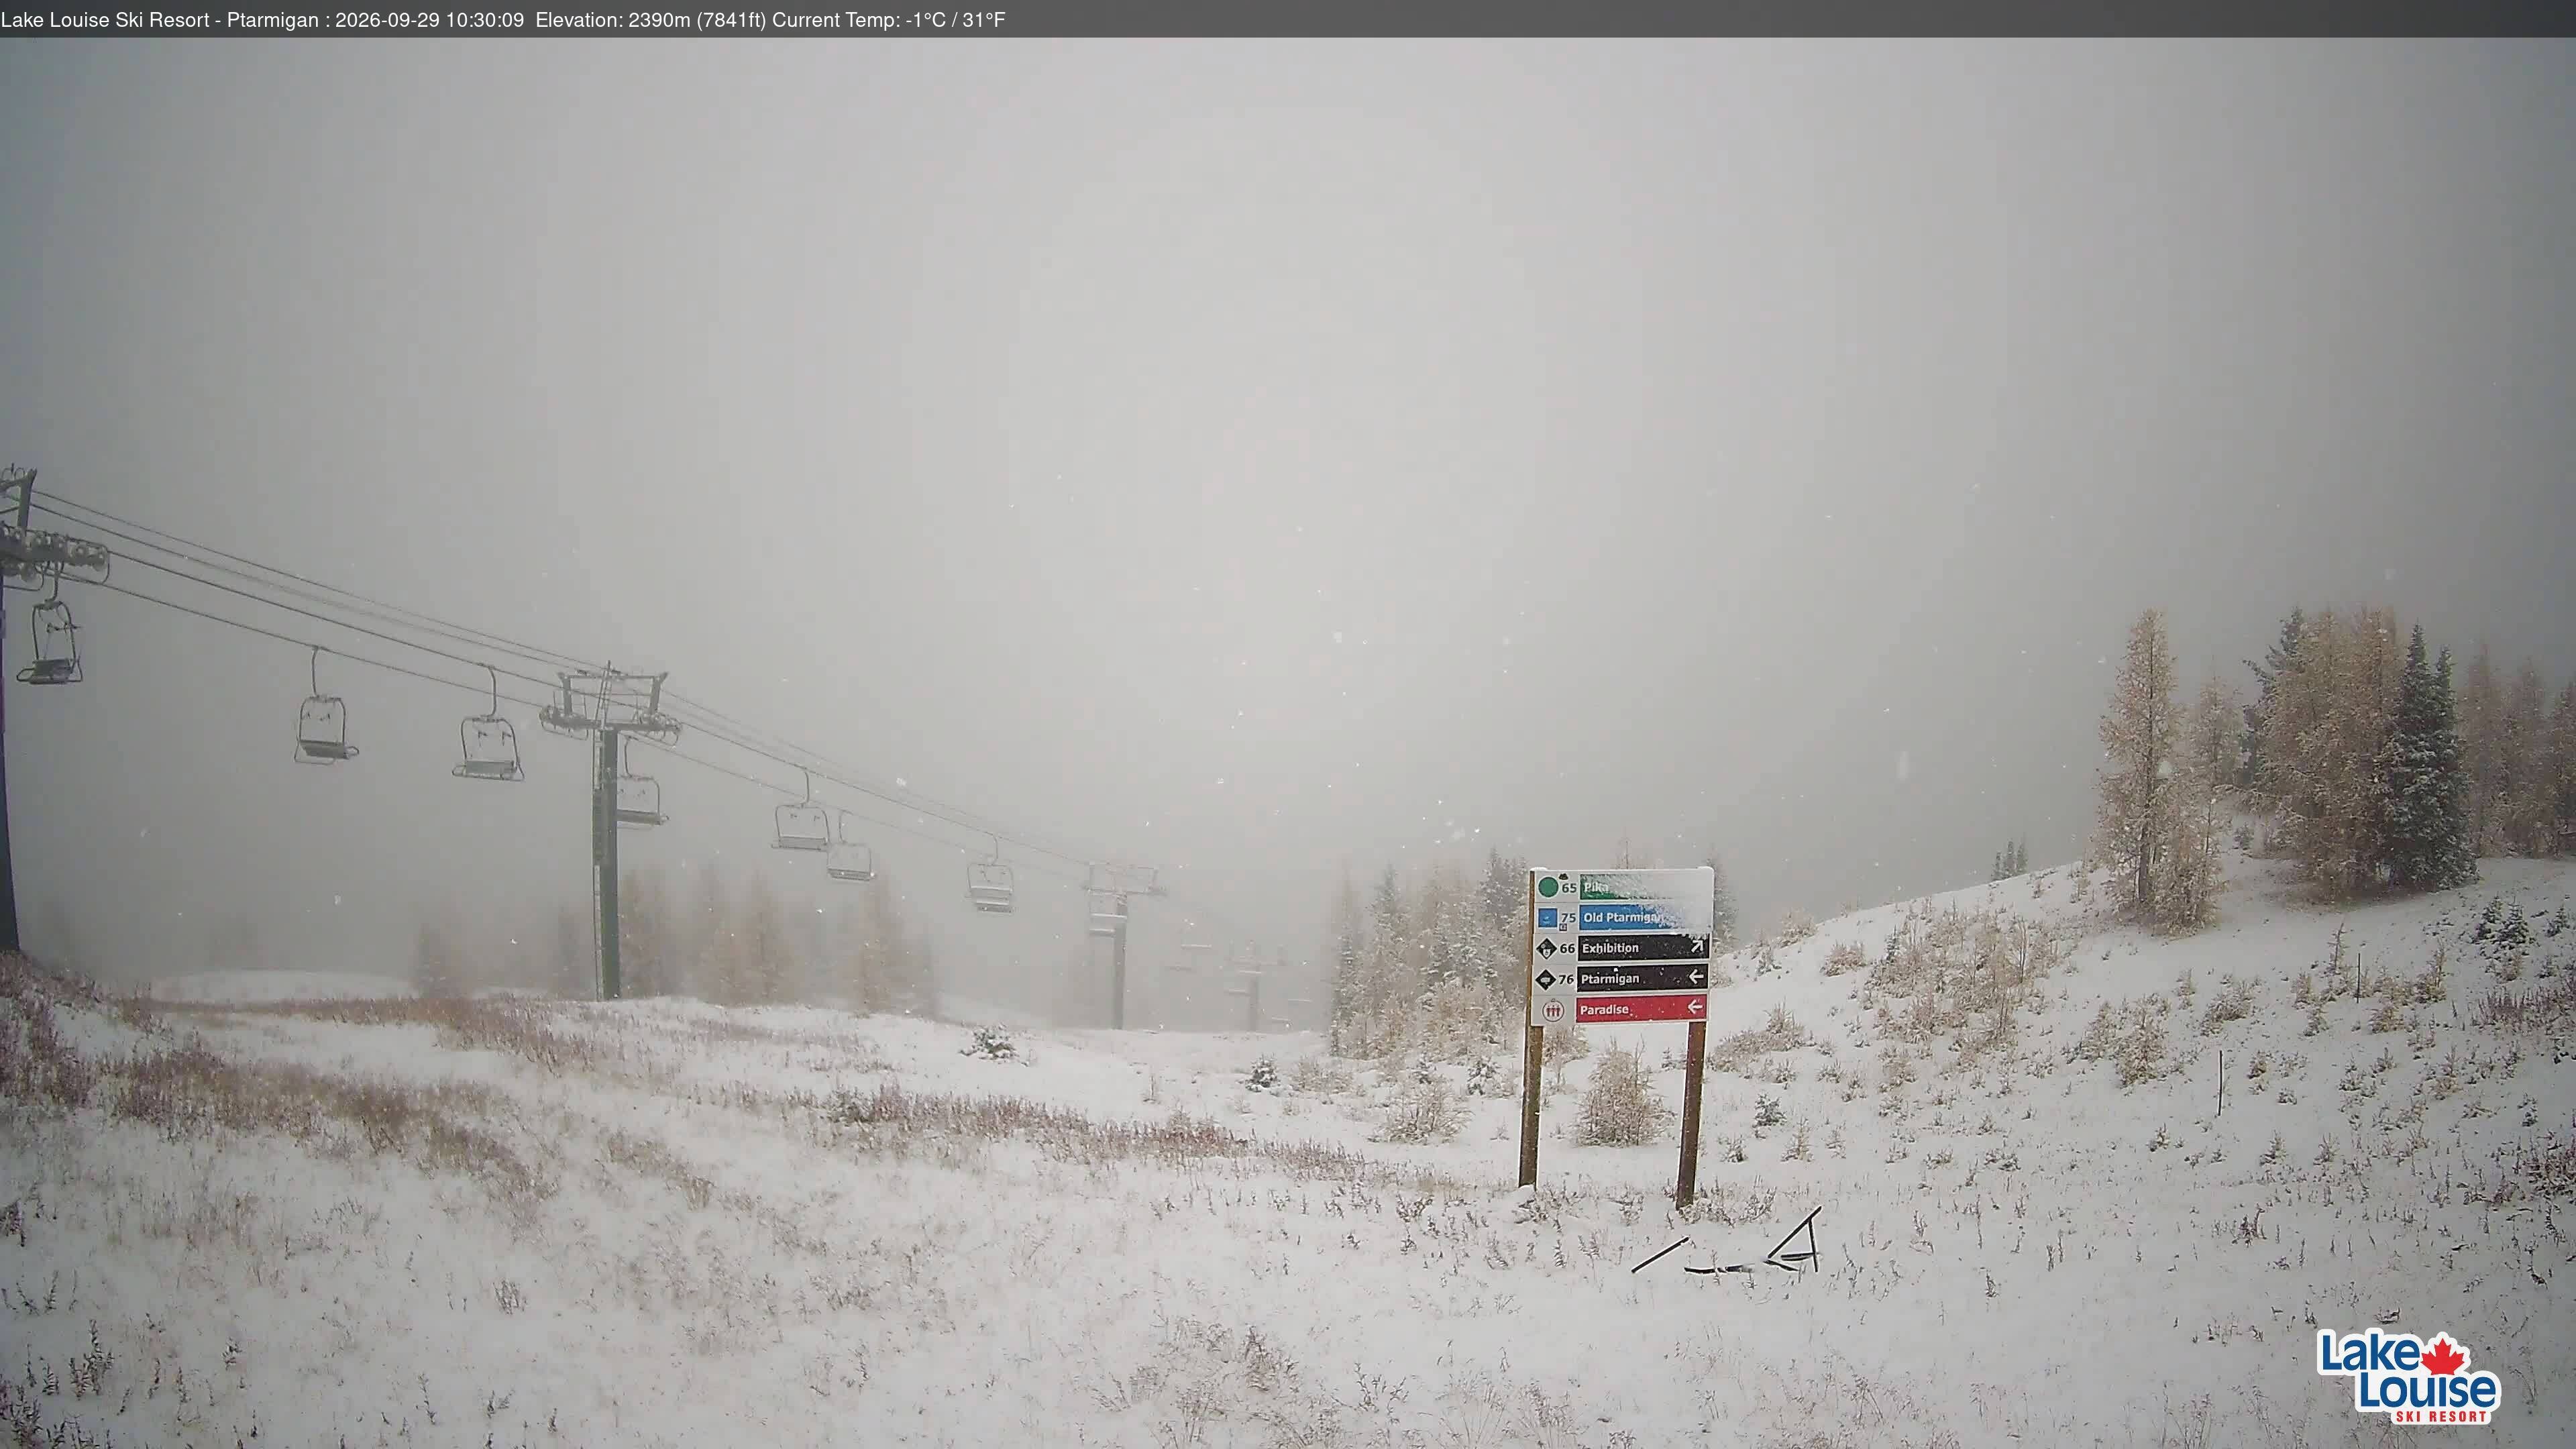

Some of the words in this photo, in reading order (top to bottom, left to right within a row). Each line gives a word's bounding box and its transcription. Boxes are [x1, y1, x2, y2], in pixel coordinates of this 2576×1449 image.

[1562, 883, 1576, 894] 65
[1584, 881, 1609, 893] Pika
[1561, 913, 1576, 923] 75
[1584, 912, 1603, 922] Old
[1560, 943, 1575, 954] 66
[1582, 943, 1640, 954] Exhibition
[1558, 974, 1574, 984] 76
[1581, 973, 1640, 985] Ptarmigan
[1580, 1004, 1629, 1015] Paradise
